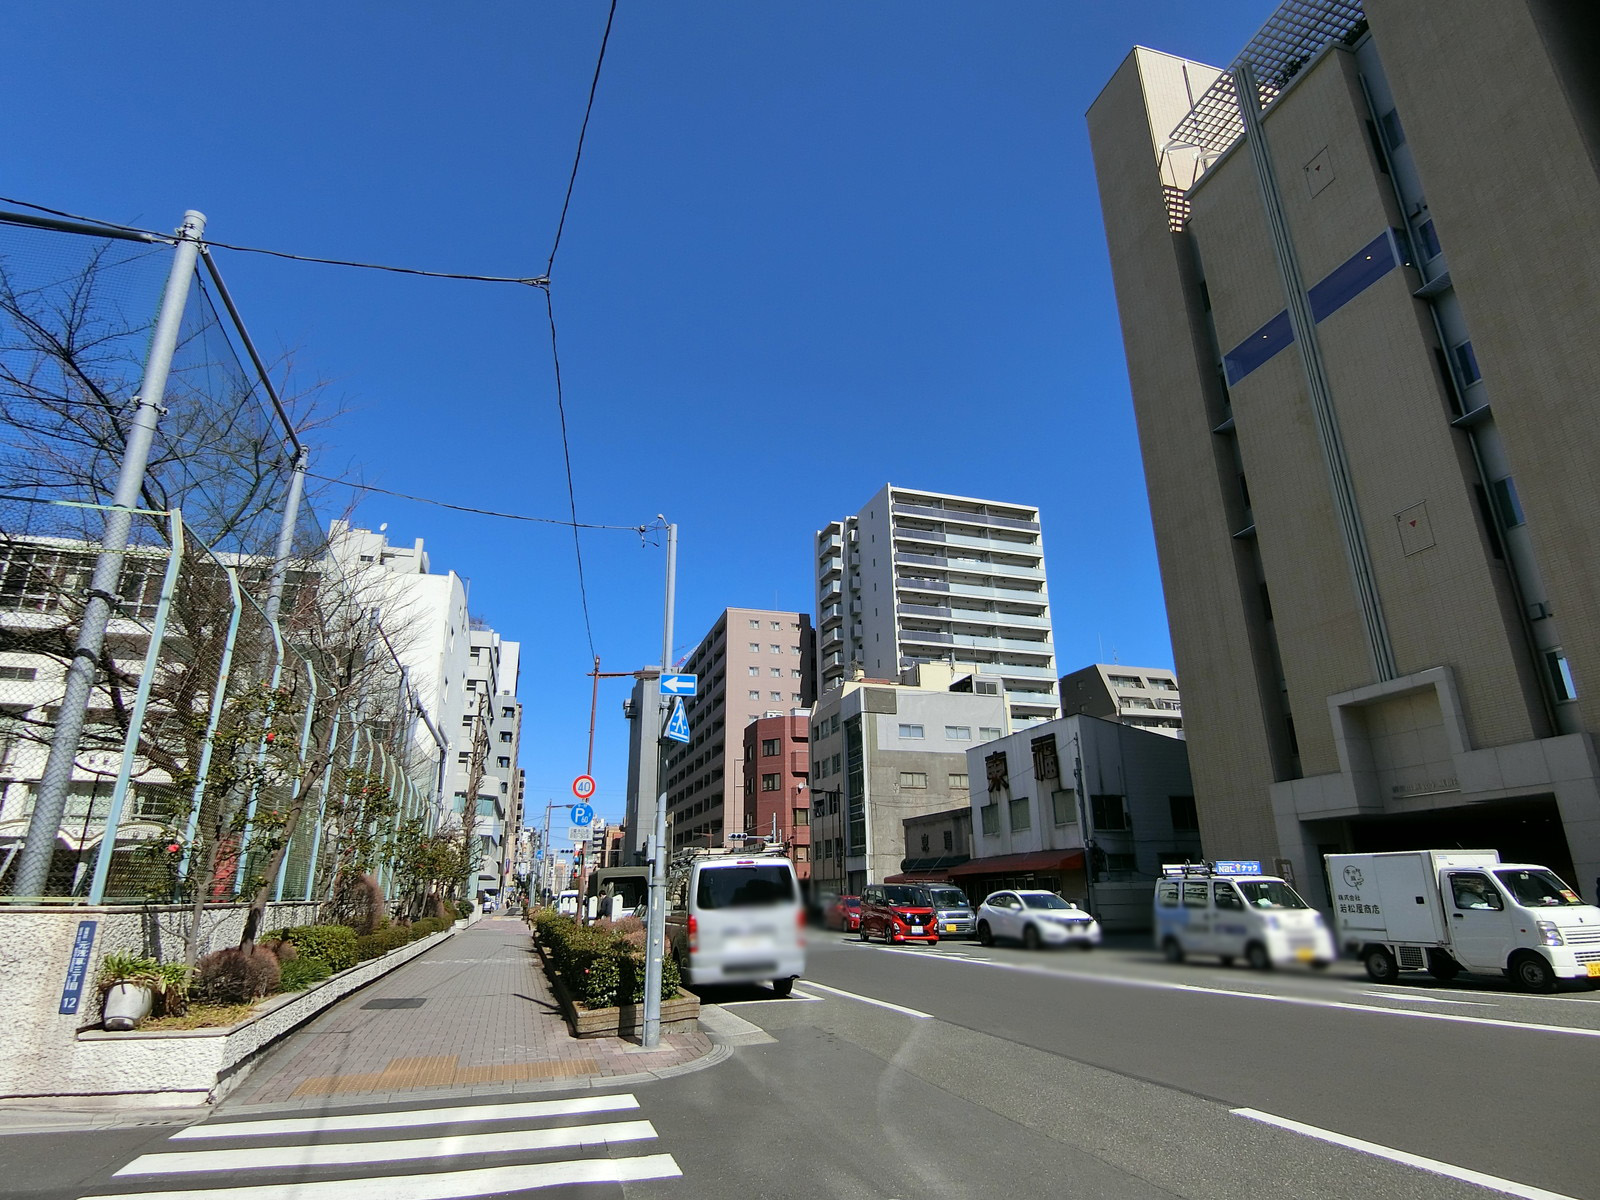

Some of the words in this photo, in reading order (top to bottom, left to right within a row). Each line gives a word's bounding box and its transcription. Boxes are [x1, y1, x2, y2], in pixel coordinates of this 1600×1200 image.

[577, 781, 591, 792] 40
[575, 807, 586, 824] P
[1338, 894, 1361, 902] 株式会社
[1340, 903, 1380, 915] 若松屋商店
[63, 997, 77, 1009] 12
